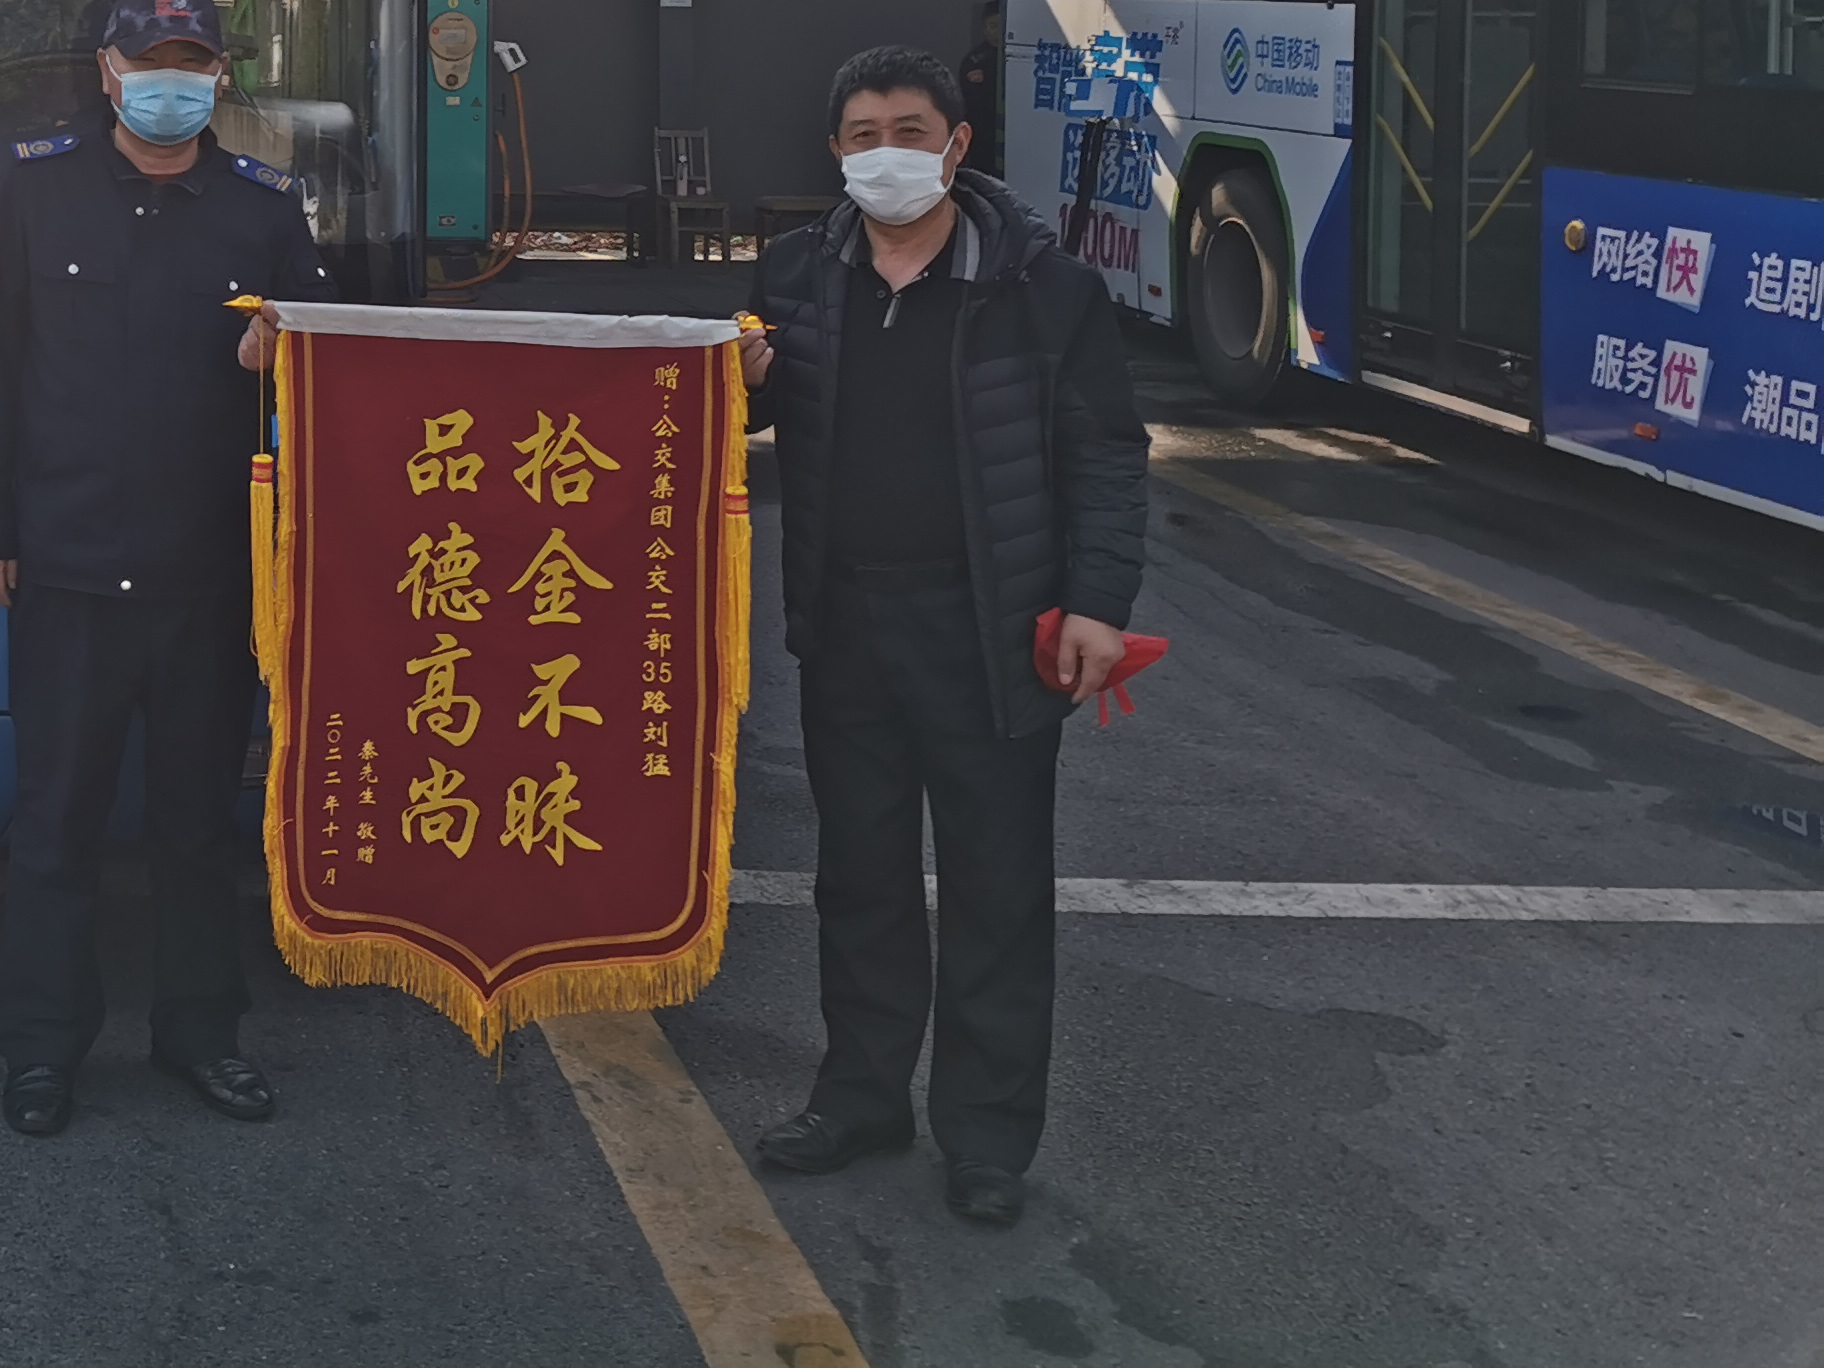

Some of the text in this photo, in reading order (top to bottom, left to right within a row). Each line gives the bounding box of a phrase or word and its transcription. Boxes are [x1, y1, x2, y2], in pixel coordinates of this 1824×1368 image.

[1255, 35, 1321, 71] 中国移动
[1255, 73, 1283, 95] China
[1285, 75, 1319, 99] Mobile
[1591, 226, 1824, 323] 网络快 追剧
[1590, 334, 1821, 445] 服务优 潮品
[396, 409, 491, 860] 品德高尚
[499, 410, 622, 868] 拾金不昧
